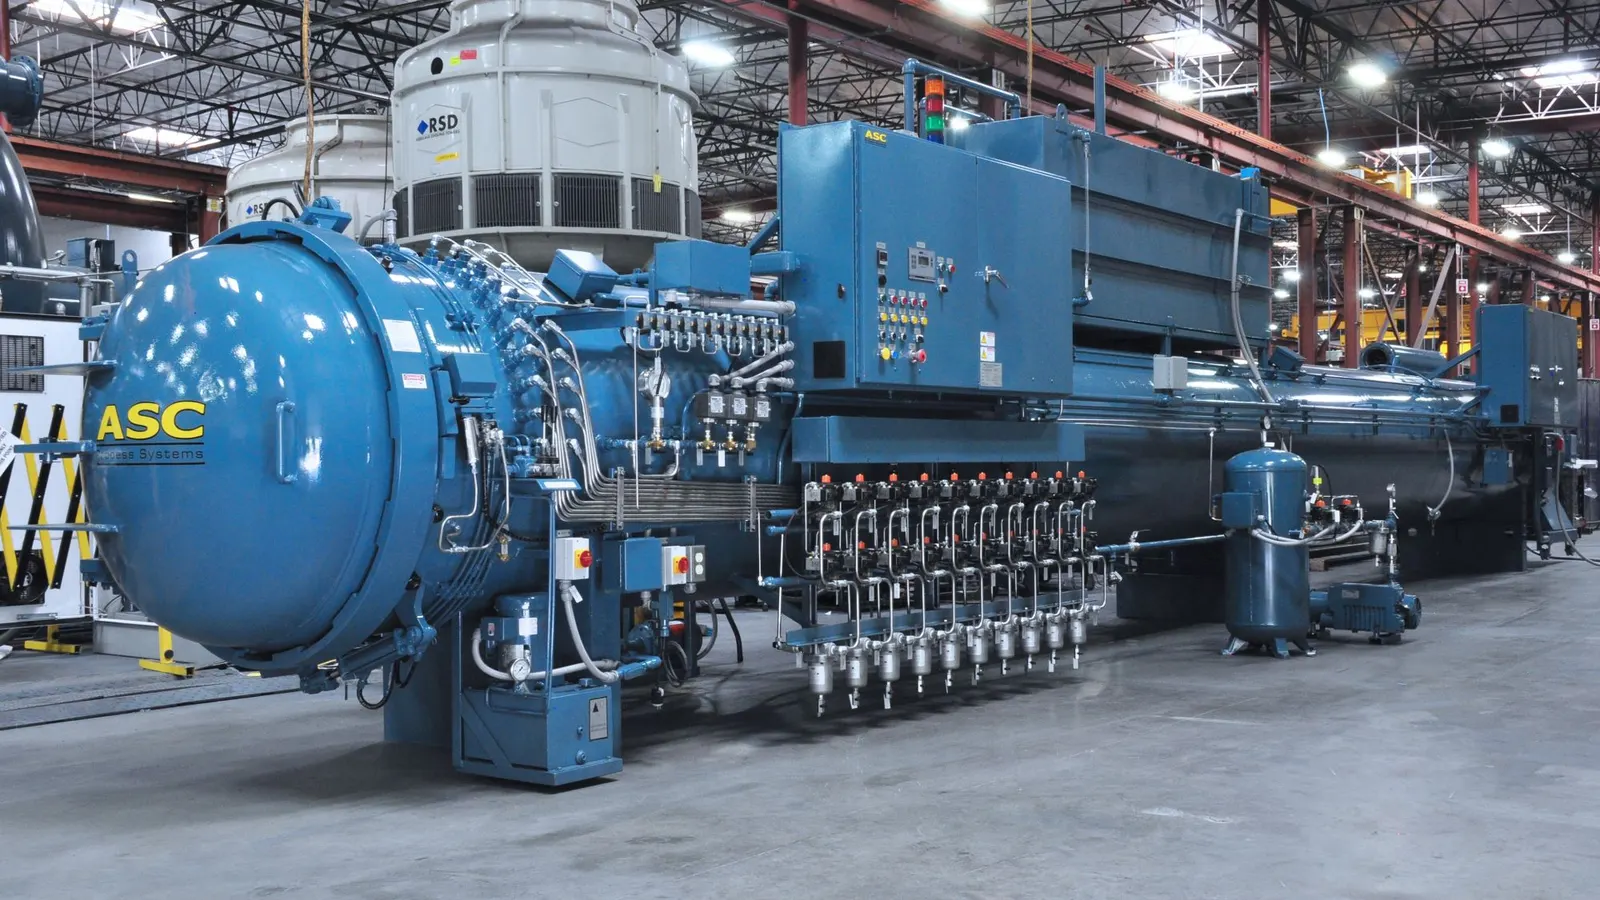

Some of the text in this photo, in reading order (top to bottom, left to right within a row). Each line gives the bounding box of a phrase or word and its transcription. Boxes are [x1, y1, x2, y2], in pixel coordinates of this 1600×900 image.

[429, 114, 458, 133] RSD
[864, 129, 887, 143] ASC
[96, 400, 206, 441] ASC
[97, 448, 204, 461] cess Systems
